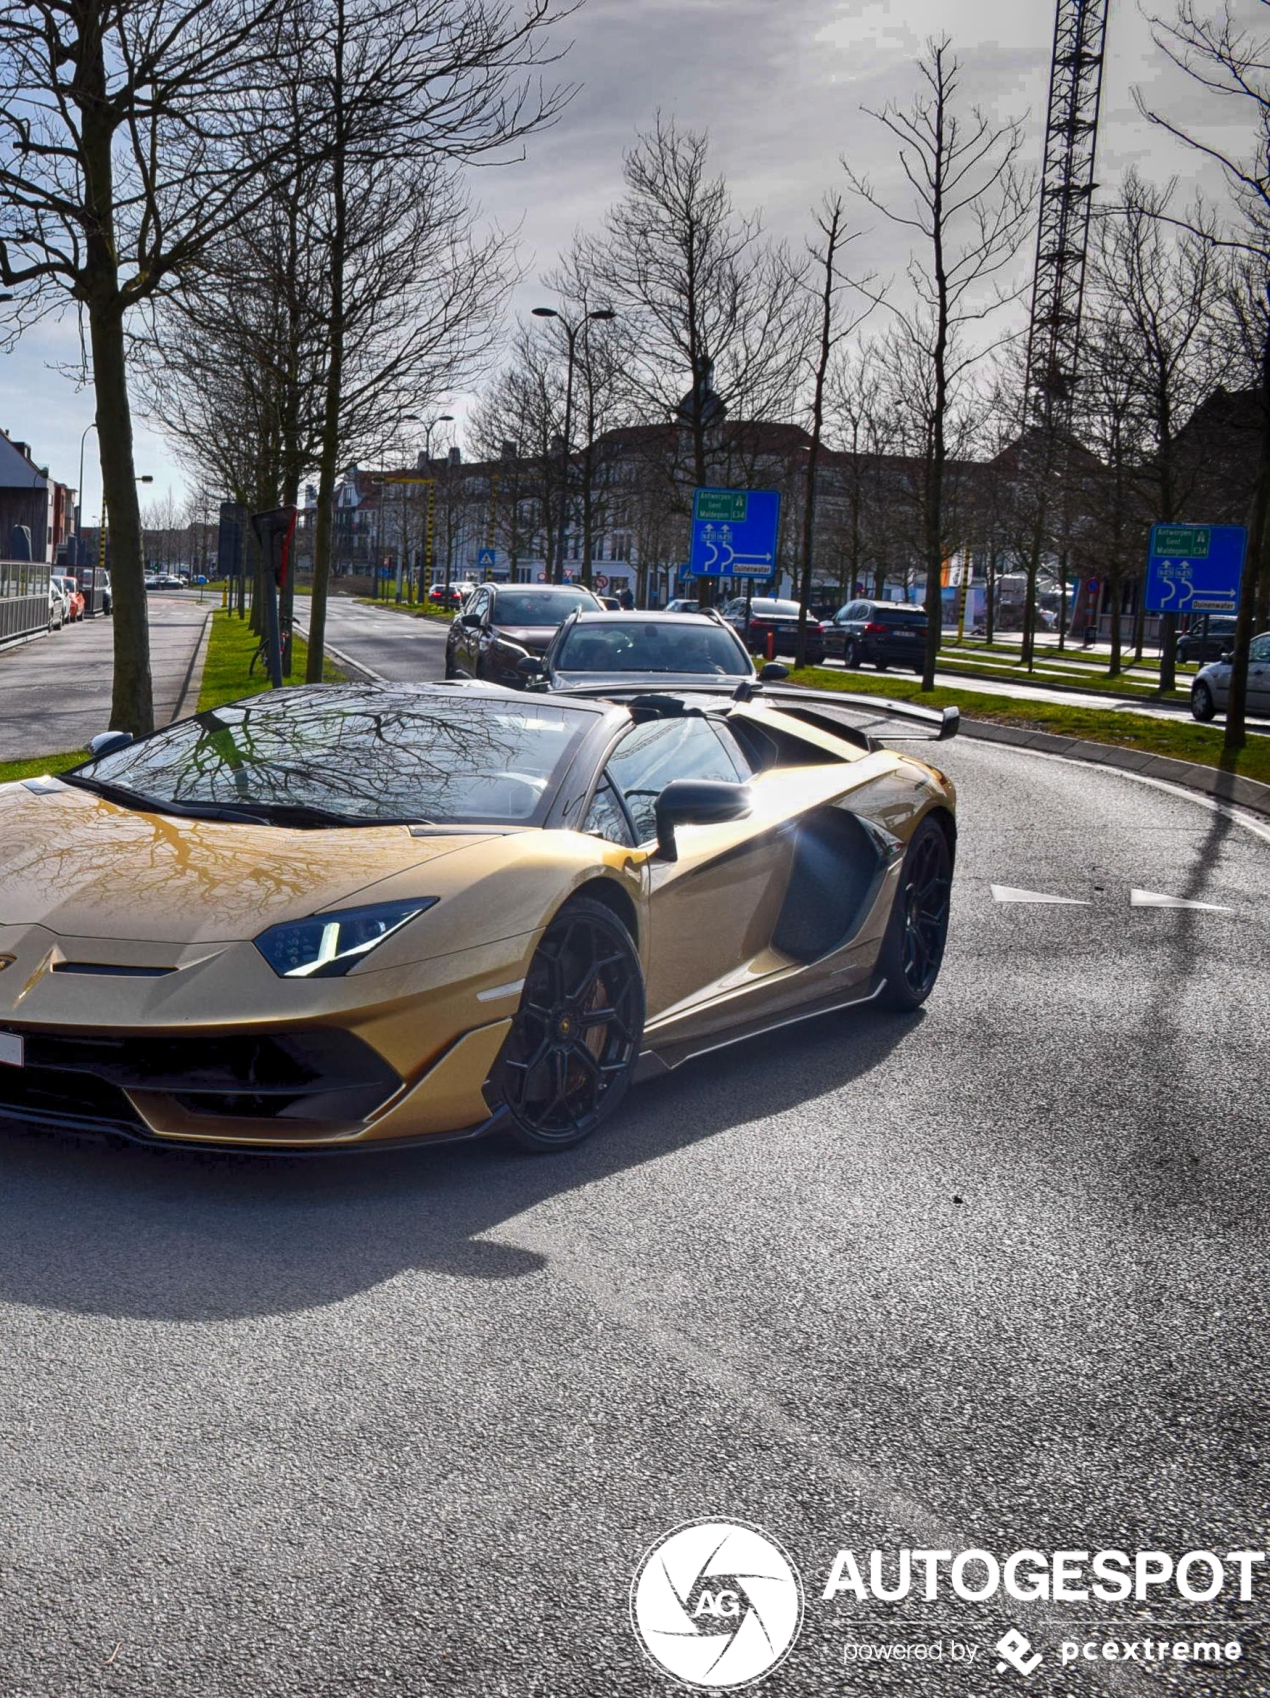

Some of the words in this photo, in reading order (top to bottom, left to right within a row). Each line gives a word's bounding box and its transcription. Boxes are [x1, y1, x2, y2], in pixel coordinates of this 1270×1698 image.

[700, 492, 731, 501] Antwerpen
[708, 501, 722, 509] Gent
[699, 510, 729, 519] Maldegem
[732, 511, 745, 519] E34
[1157, 528, 1192, 537] Antwerpen
[1165, 537, 1181, 545] Gent
[1156, 547, 1189, 556] Maldegem
[1193, 547, 1207, 555] E34
[1193, 600, 1234, 610] Duinenwater
